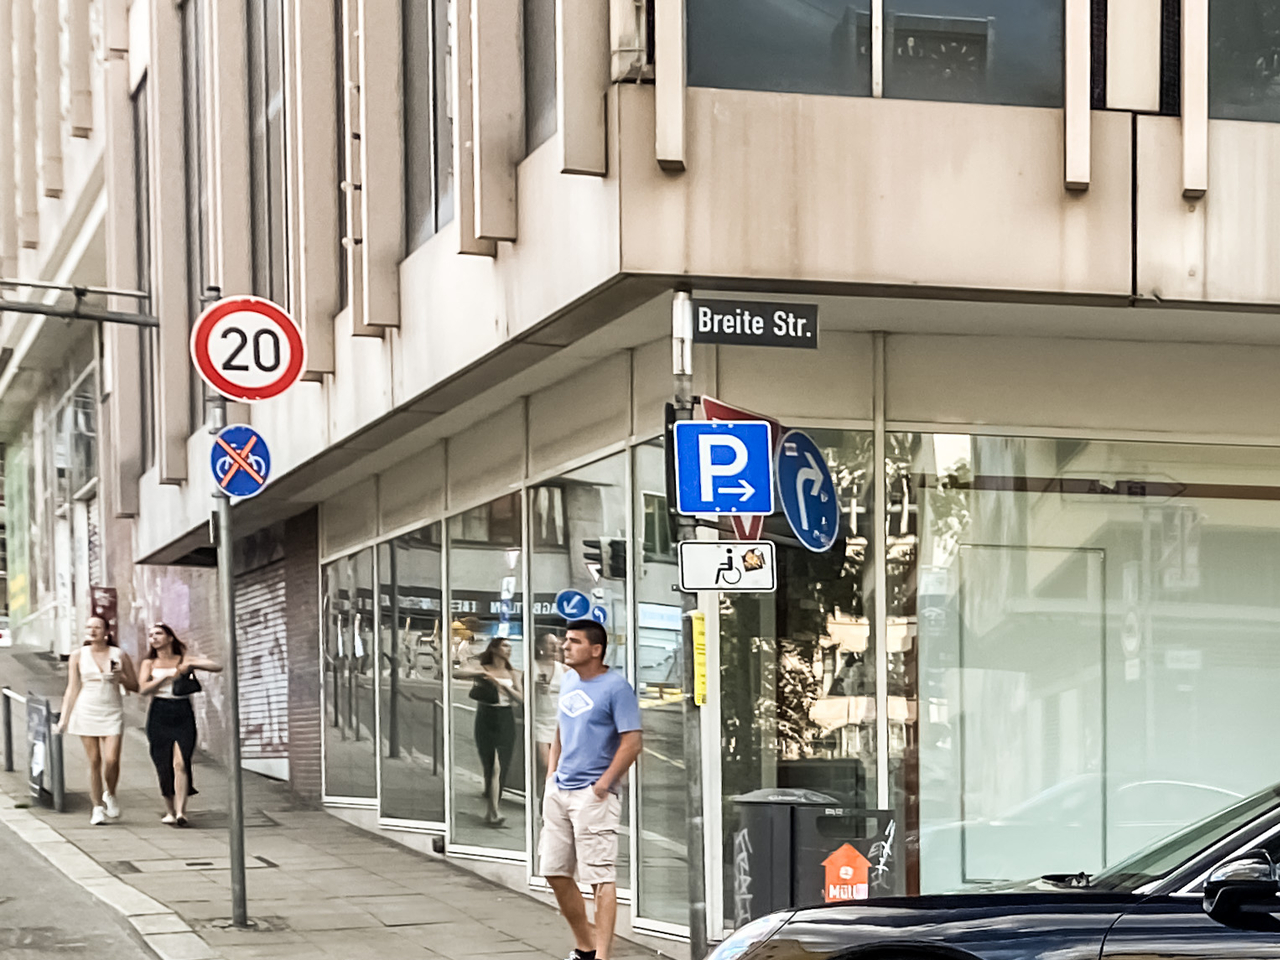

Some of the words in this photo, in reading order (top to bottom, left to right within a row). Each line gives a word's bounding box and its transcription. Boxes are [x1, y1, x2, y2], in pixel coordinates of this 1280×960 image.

[698, 306, 764, 334] Breite
[773, 310, 812, 338] Str.
[221, 327, 280, 372] 20
[698, 434, 748, 502] P
